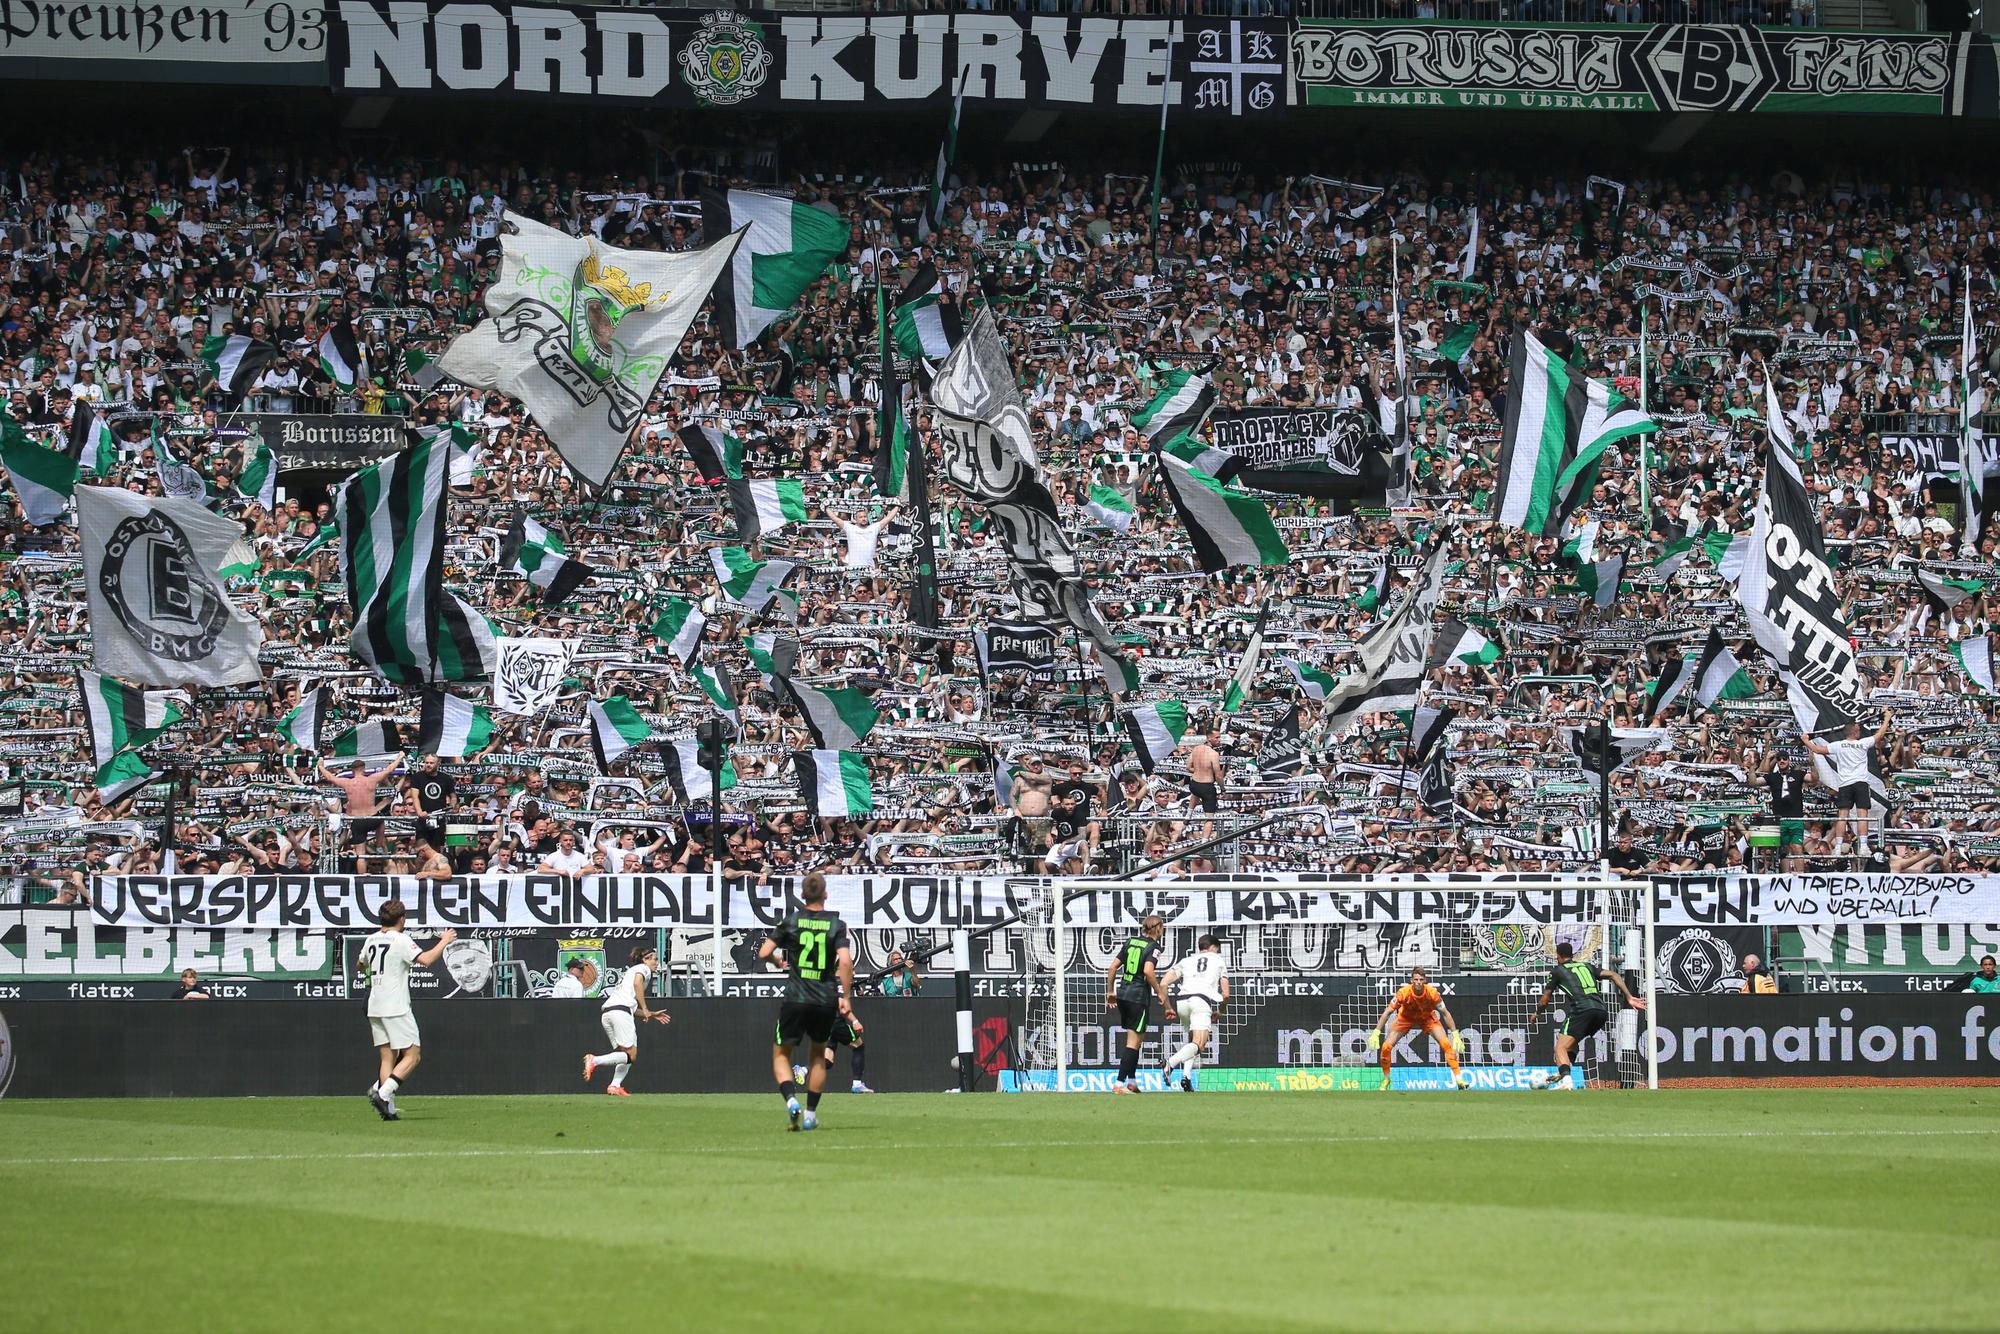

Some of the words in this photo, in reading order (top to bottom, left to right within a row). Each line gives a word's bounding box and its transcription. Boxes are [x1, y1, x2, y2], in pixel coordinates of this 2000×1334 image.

[343, 0, 670, 97] NORD
[780, 14, 1182, 105] KURVE
[1293, 30, 1620, 94] BORUSSIA
[1785, 32, 1951, 95] FANS
[1353, 90, 1445, 106] IMMER
[1456, 91, 1507, 107] UND
[1518, 90, 1644, 110] ÜBERALL!
[719, 408, 769, 421] BORUSSIA
[280, 420, 397, 446] Borussen
[1798, 876, 1864, 895] TRIER,
[1868, 876, 1975, 896] WÜRZBURG
[92, 876, 507, 925] VERSPRECHEN
[1775, 898, 1818, 914] UND
[603, 927, 647, 938] 2006
[1680, 928, 1711, 939] 1900
[368, 943, 391, 976] 27
[798, 931, 828, 970] 21
[1197, 957, 1208, 972] 8
[1405, 1078, 1441, 1090] www.
